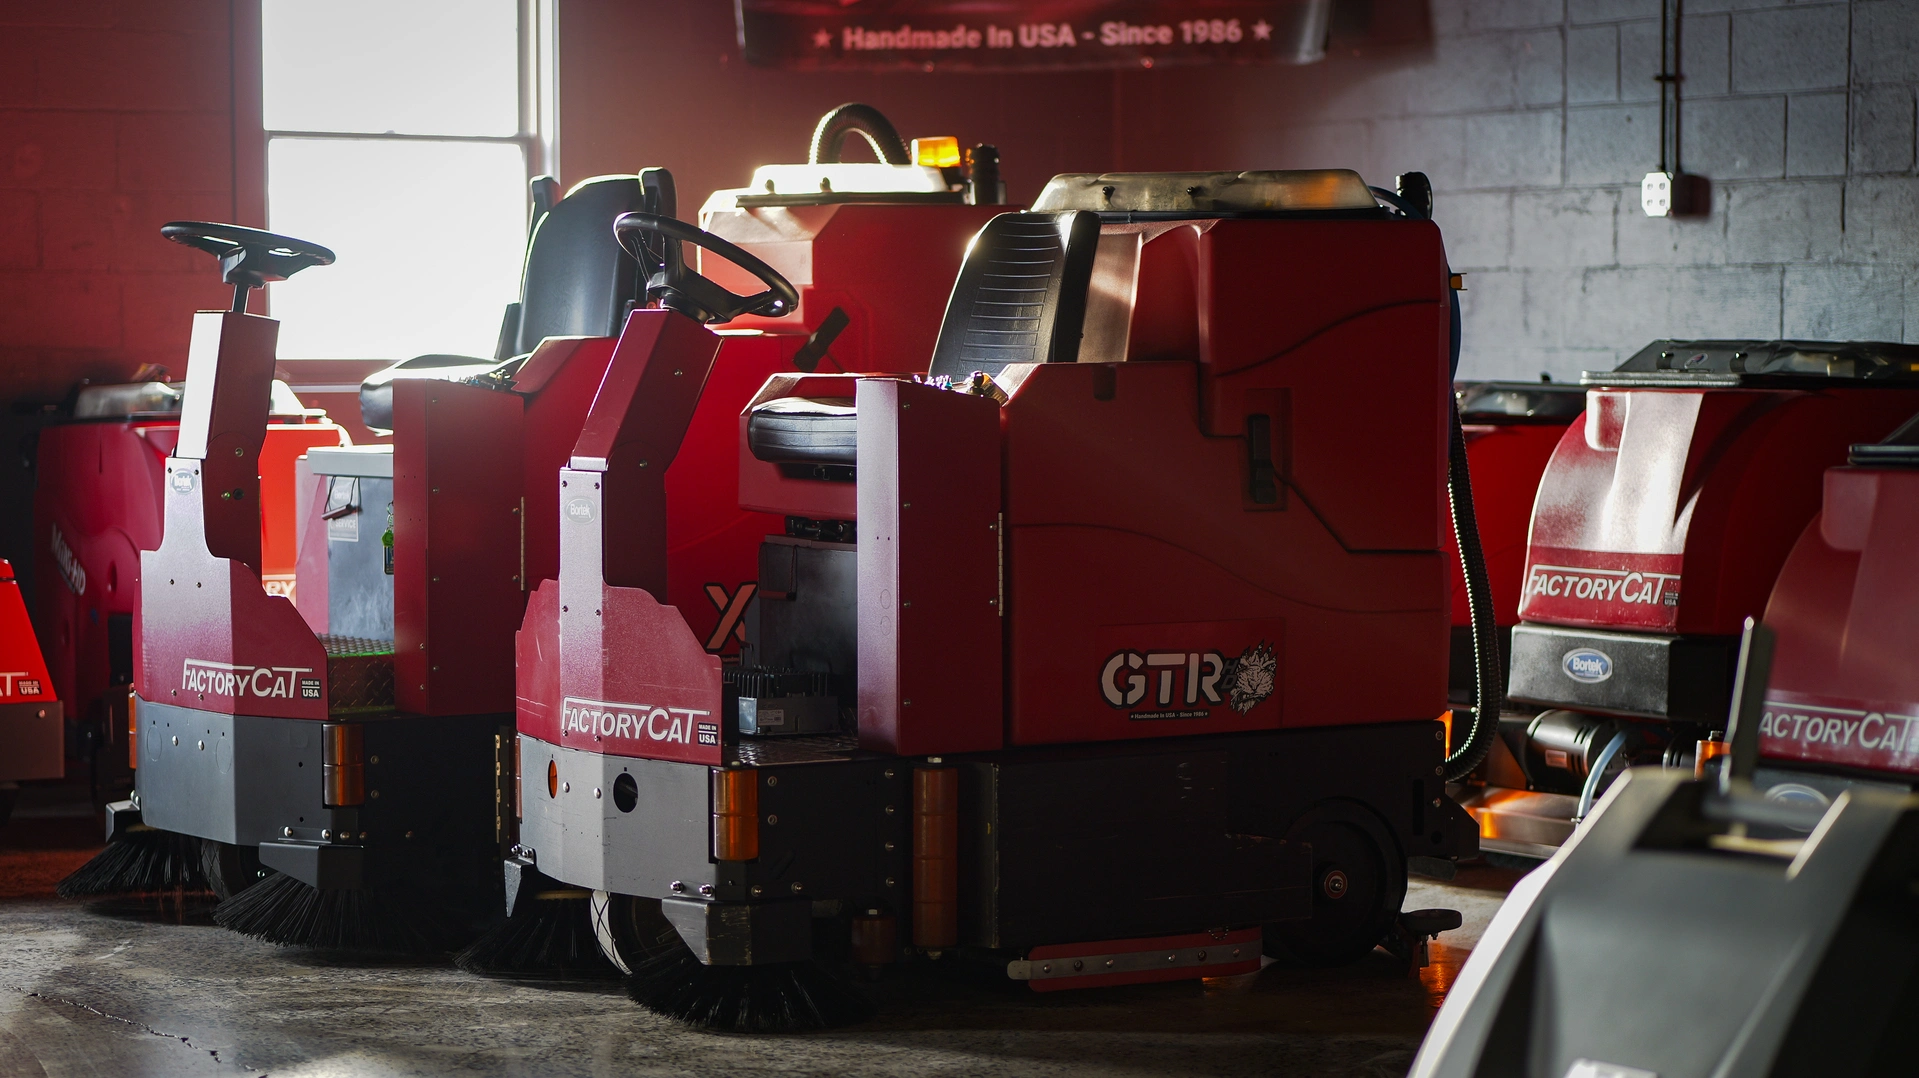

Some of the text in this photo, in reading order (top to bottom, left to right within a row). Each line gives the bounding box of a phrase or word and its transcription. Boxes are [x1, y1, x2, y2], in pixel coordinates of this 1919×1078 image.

[842, 24, 981, 50] Handmade
[986, 25, 1014, 48] In
[1018, 24, 1076, 48] USA
[1101, 21, 1174, 46] Since
[1178, 18, 1243, 44] 1986
[570, 503, 591, 518] Bortek
[1572, 657, 1603, 676] Bortek
[1101, 652, 1224, 706] GTR
[302, 688, 320, 698] USA
[699, 734, 716, 744] USA
